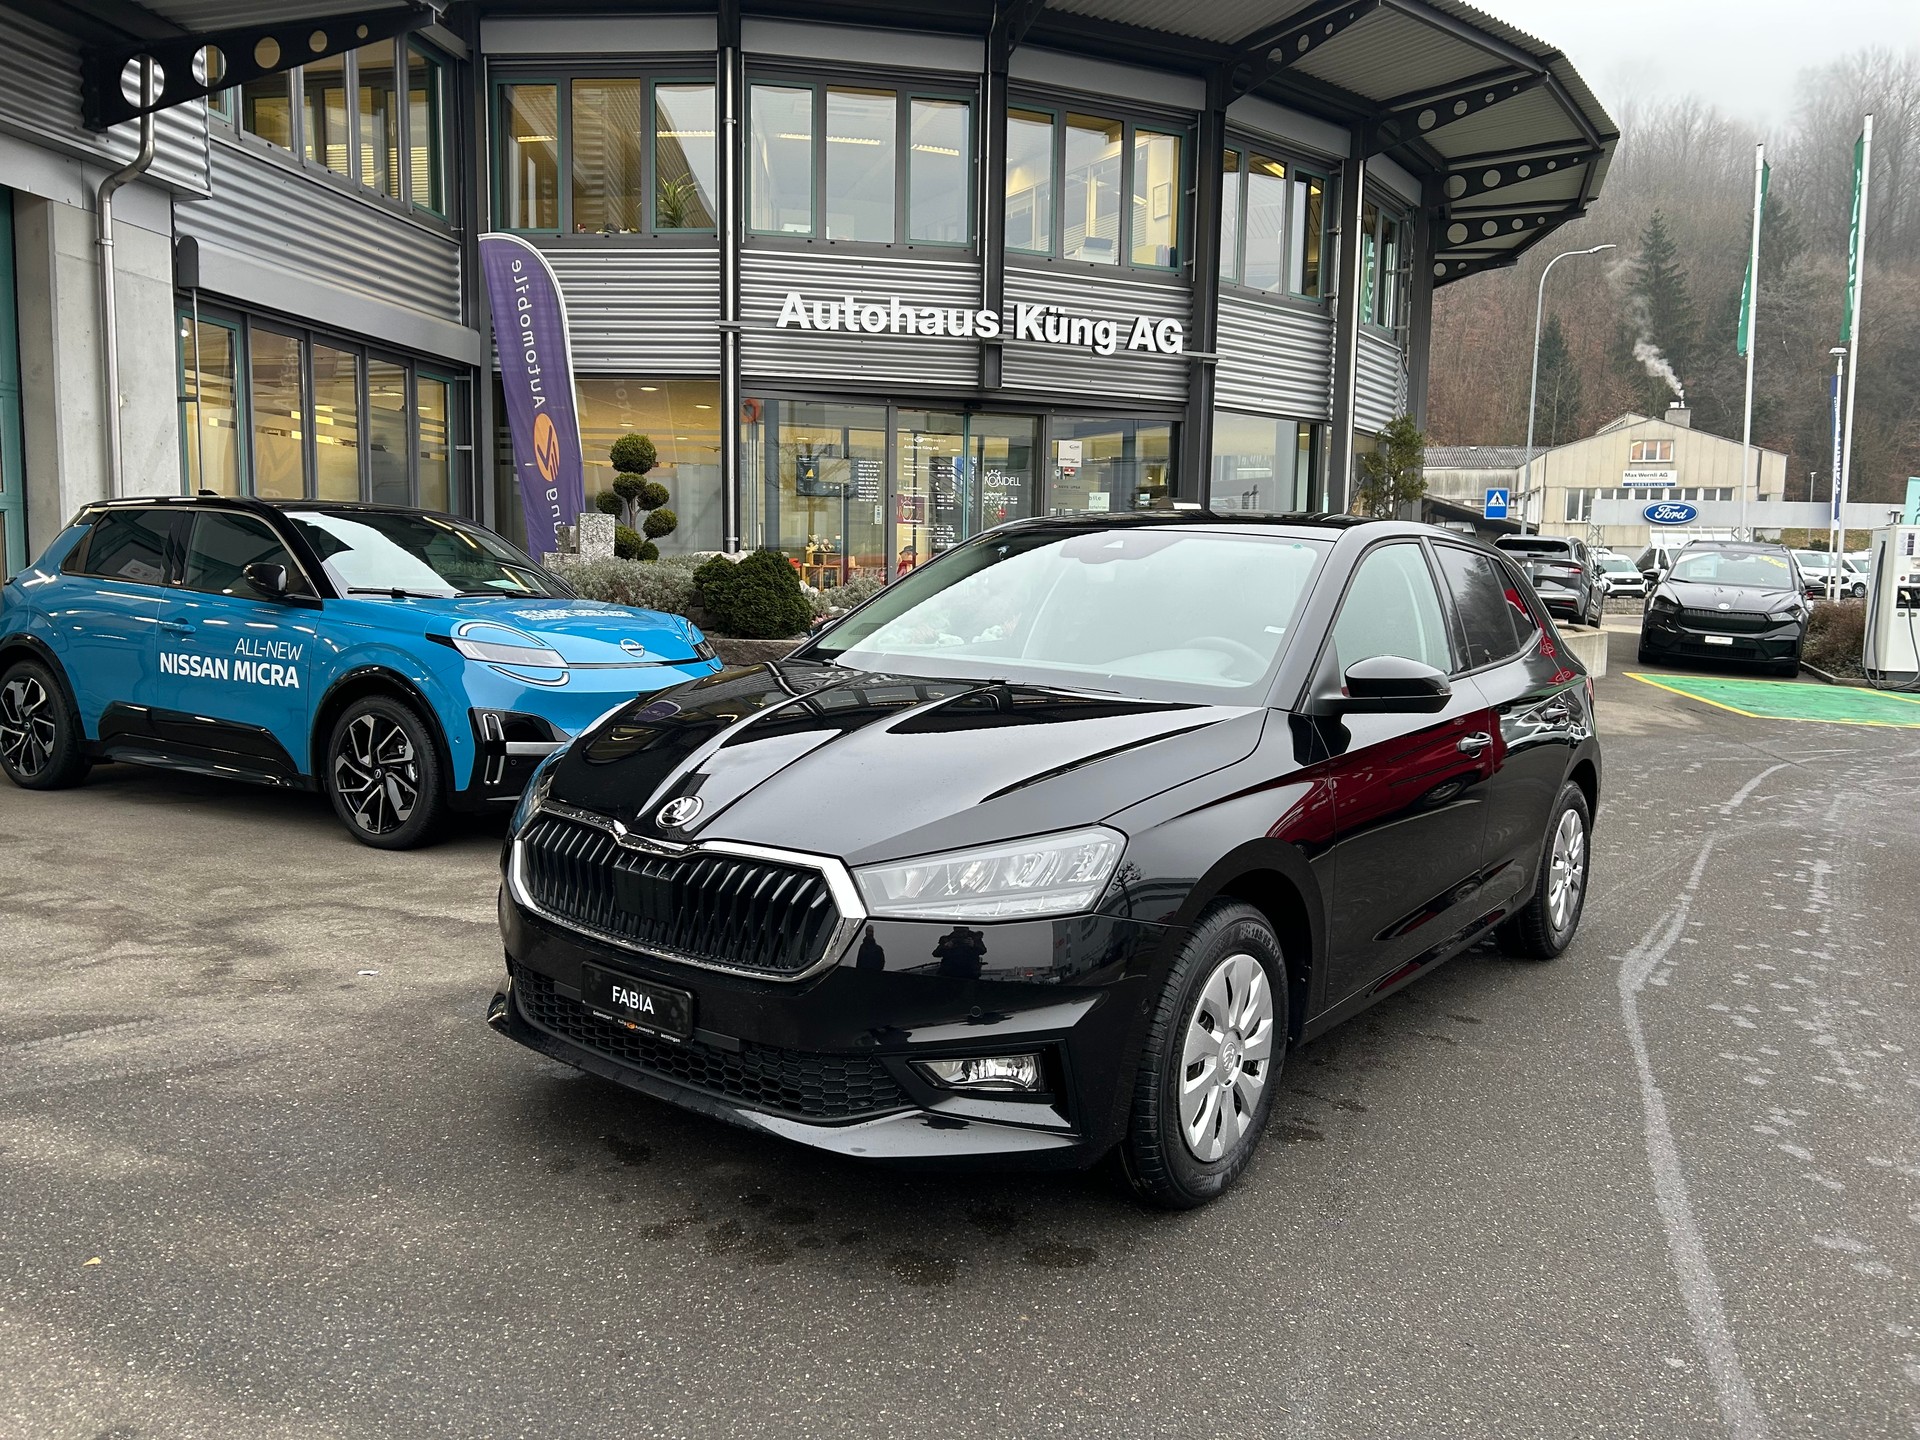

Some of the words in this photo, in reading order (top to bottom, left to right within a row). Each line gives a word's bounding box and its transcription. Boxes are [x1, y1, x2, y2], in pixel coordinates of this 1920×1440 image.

[776, 291, 999, 339] Autohaus
[1014, 303, 1118, 355] Küng
[1128, 316, 1184, 354] AG
[1654, 504, 1688, 520] Ford
[234, 637, 303, 661] ALL-NEW
[160, 652, 228, 680] NISSAN
[233, 661, 300, 689] MICRA
[612, 985, 655, 1015] FABIA
